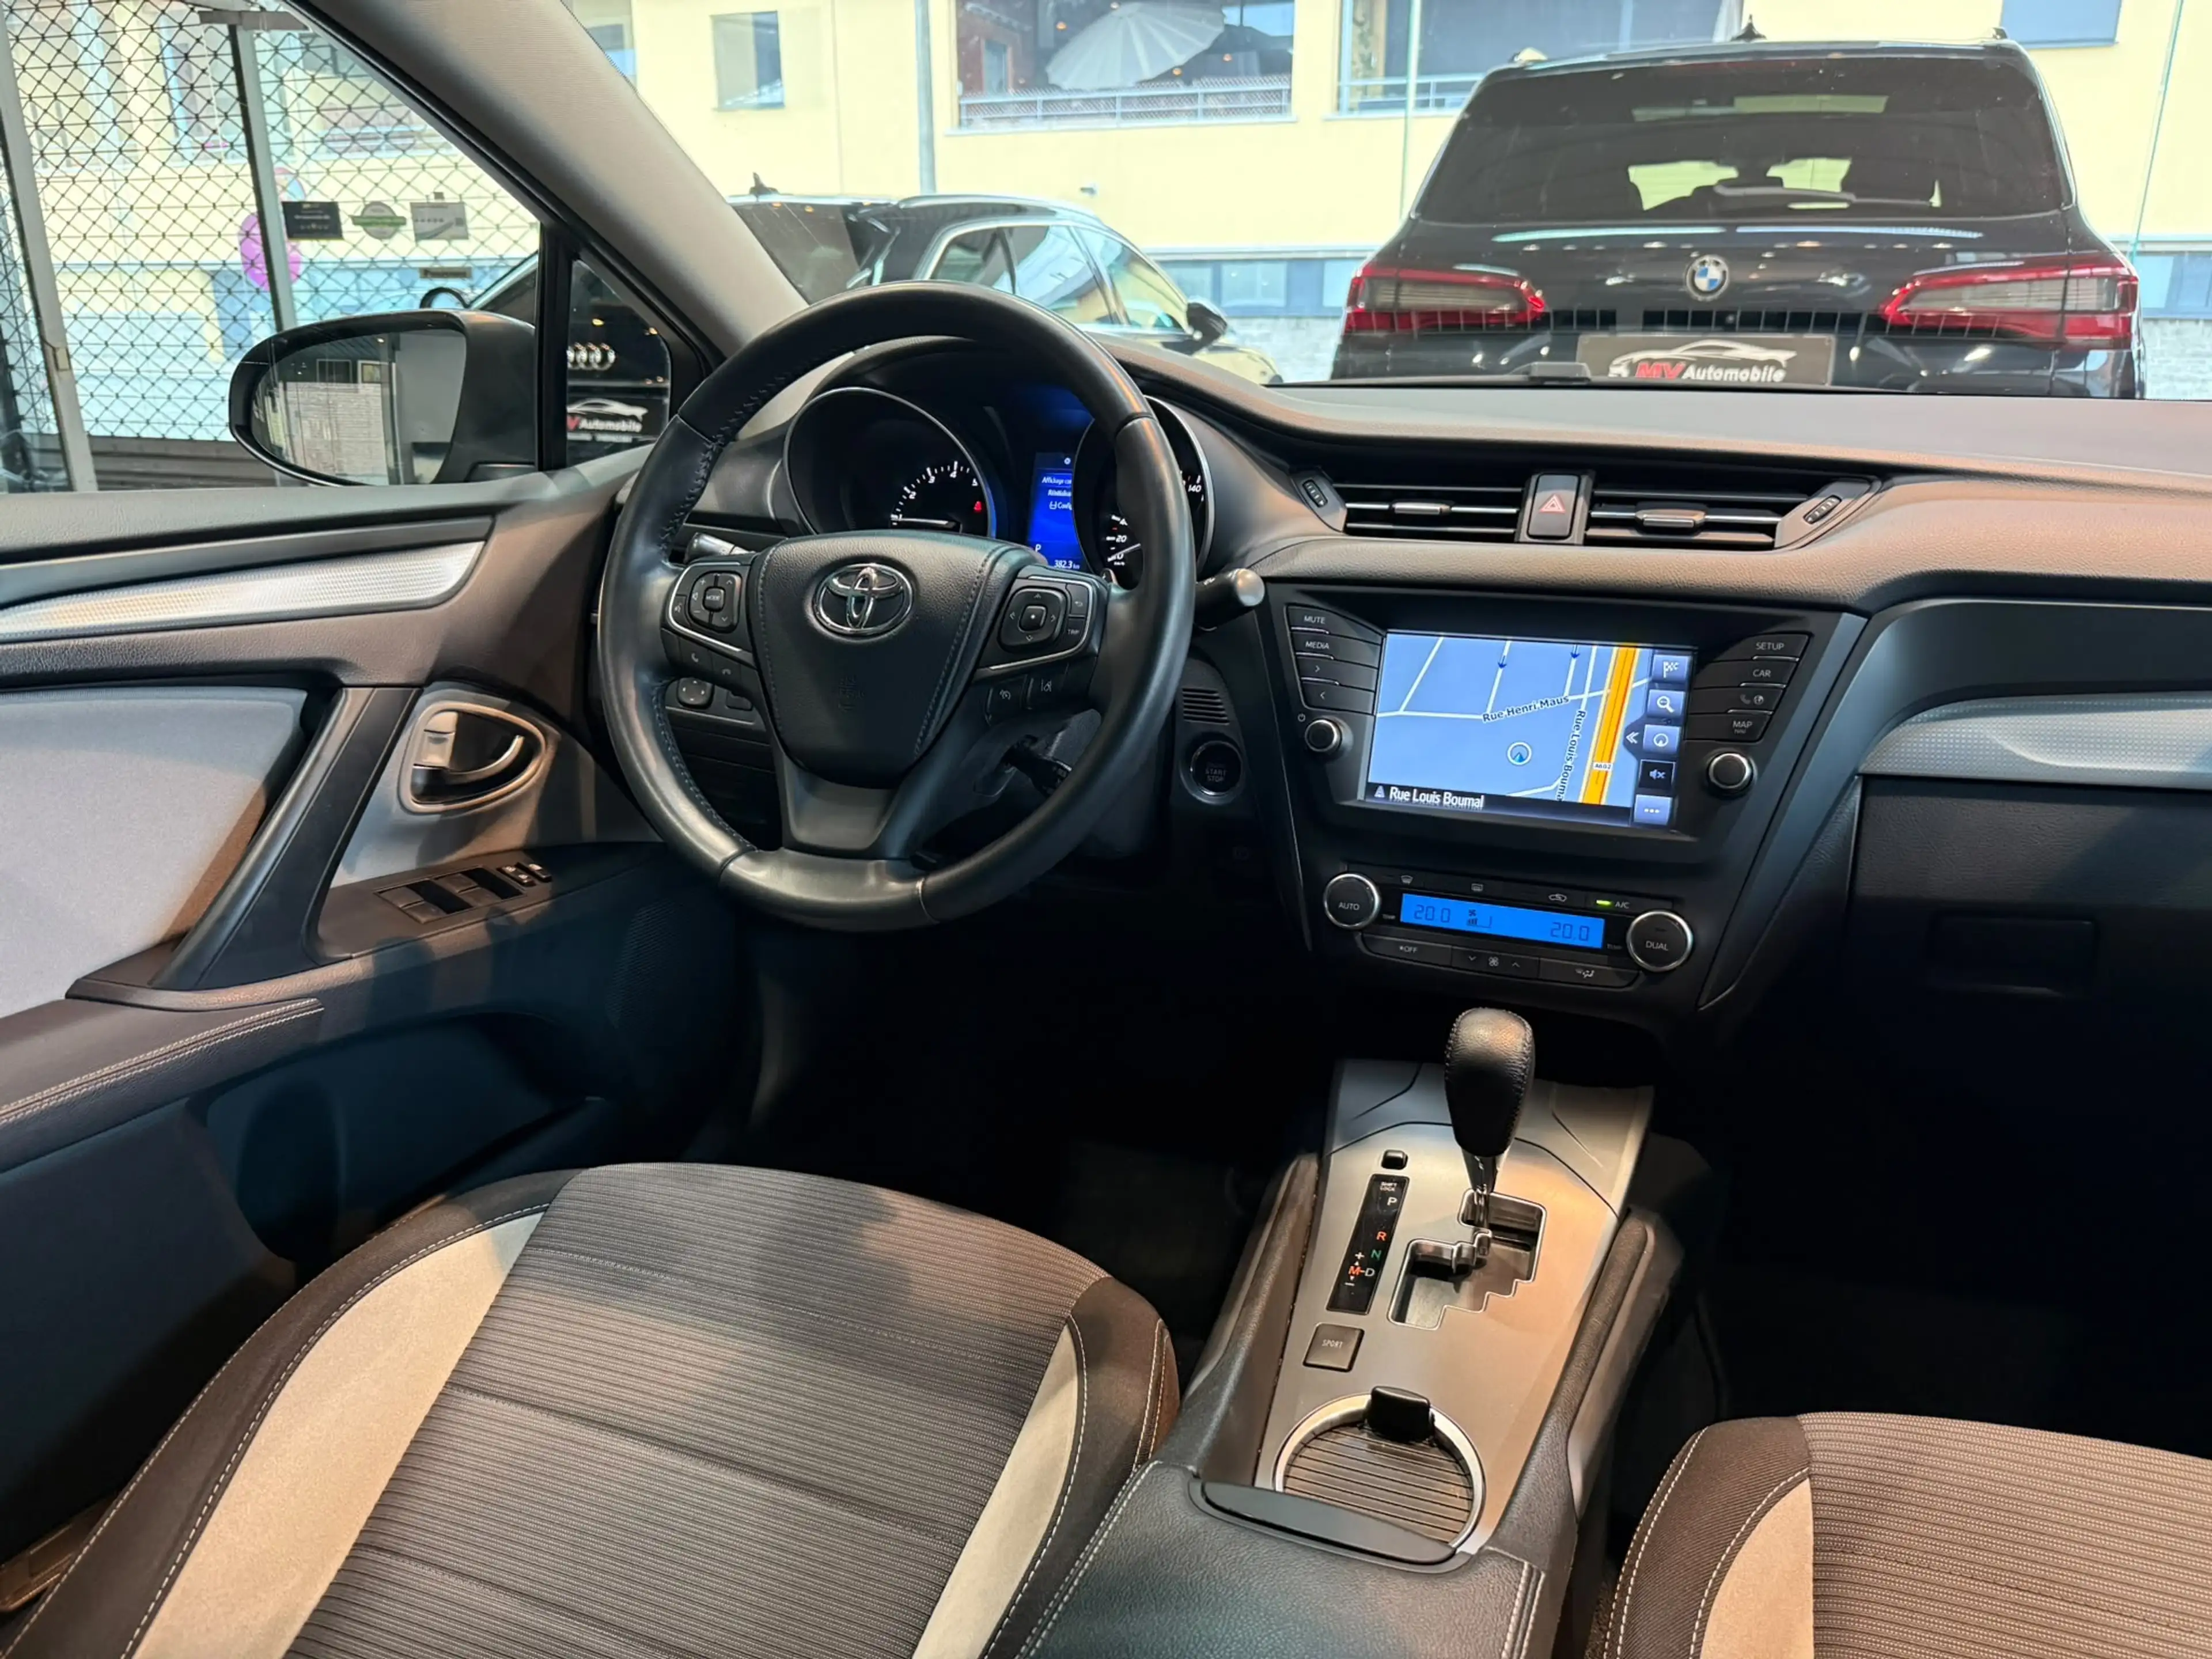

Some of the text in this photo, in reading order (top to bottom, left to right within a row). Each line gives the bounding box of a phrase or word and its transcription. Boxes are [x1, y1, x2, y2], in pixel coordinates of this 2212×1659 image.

[1635, 362, 1786, 382] MV Automobile
[949, 471, 957, 479] 4
[928, 476, 935, 484] 3
[1188, 484, 1202, 493] 140
[908, 491, 916, 499] 2
[1115, 535, 1127, 543] 20
[1035, 544, 1041, 552] P
[1054, 559, 1073, 569] 382.3
[1304, 615, 1325, 624] MUTE
[1305, 641, 1330, 650] MEDIA
[1755, 642, 1785, 650] SETUP
[1753, 669, 1771, 677] CAR
[1483, 696, 1570, 722] Rue Henri Maus
[1573, 710, 1586, 731] Rue
[1733, 721, 1753, 729] MAP
[1566, 733, 1580, 762] Louis
[1205, 768, 1226, 777] START
[1389, 786, 1485, 808] Rue Louis Boumal
[1338, 902, 1360, 911] AUTO
[1615, 901, 1630, 909] A/C
[1550, 922, 1590, 941] 20.0
[1645, 940, 1669, 951] DUAL
[1387, 1196, 1397, 1206] P
[1376, 1232, 1388, 1241] R
[1371, 1249, 1382, 1260] N
[1364, 1268, 1376, 1277] D
[1321, 1339, 1343, 1349] SPORT
